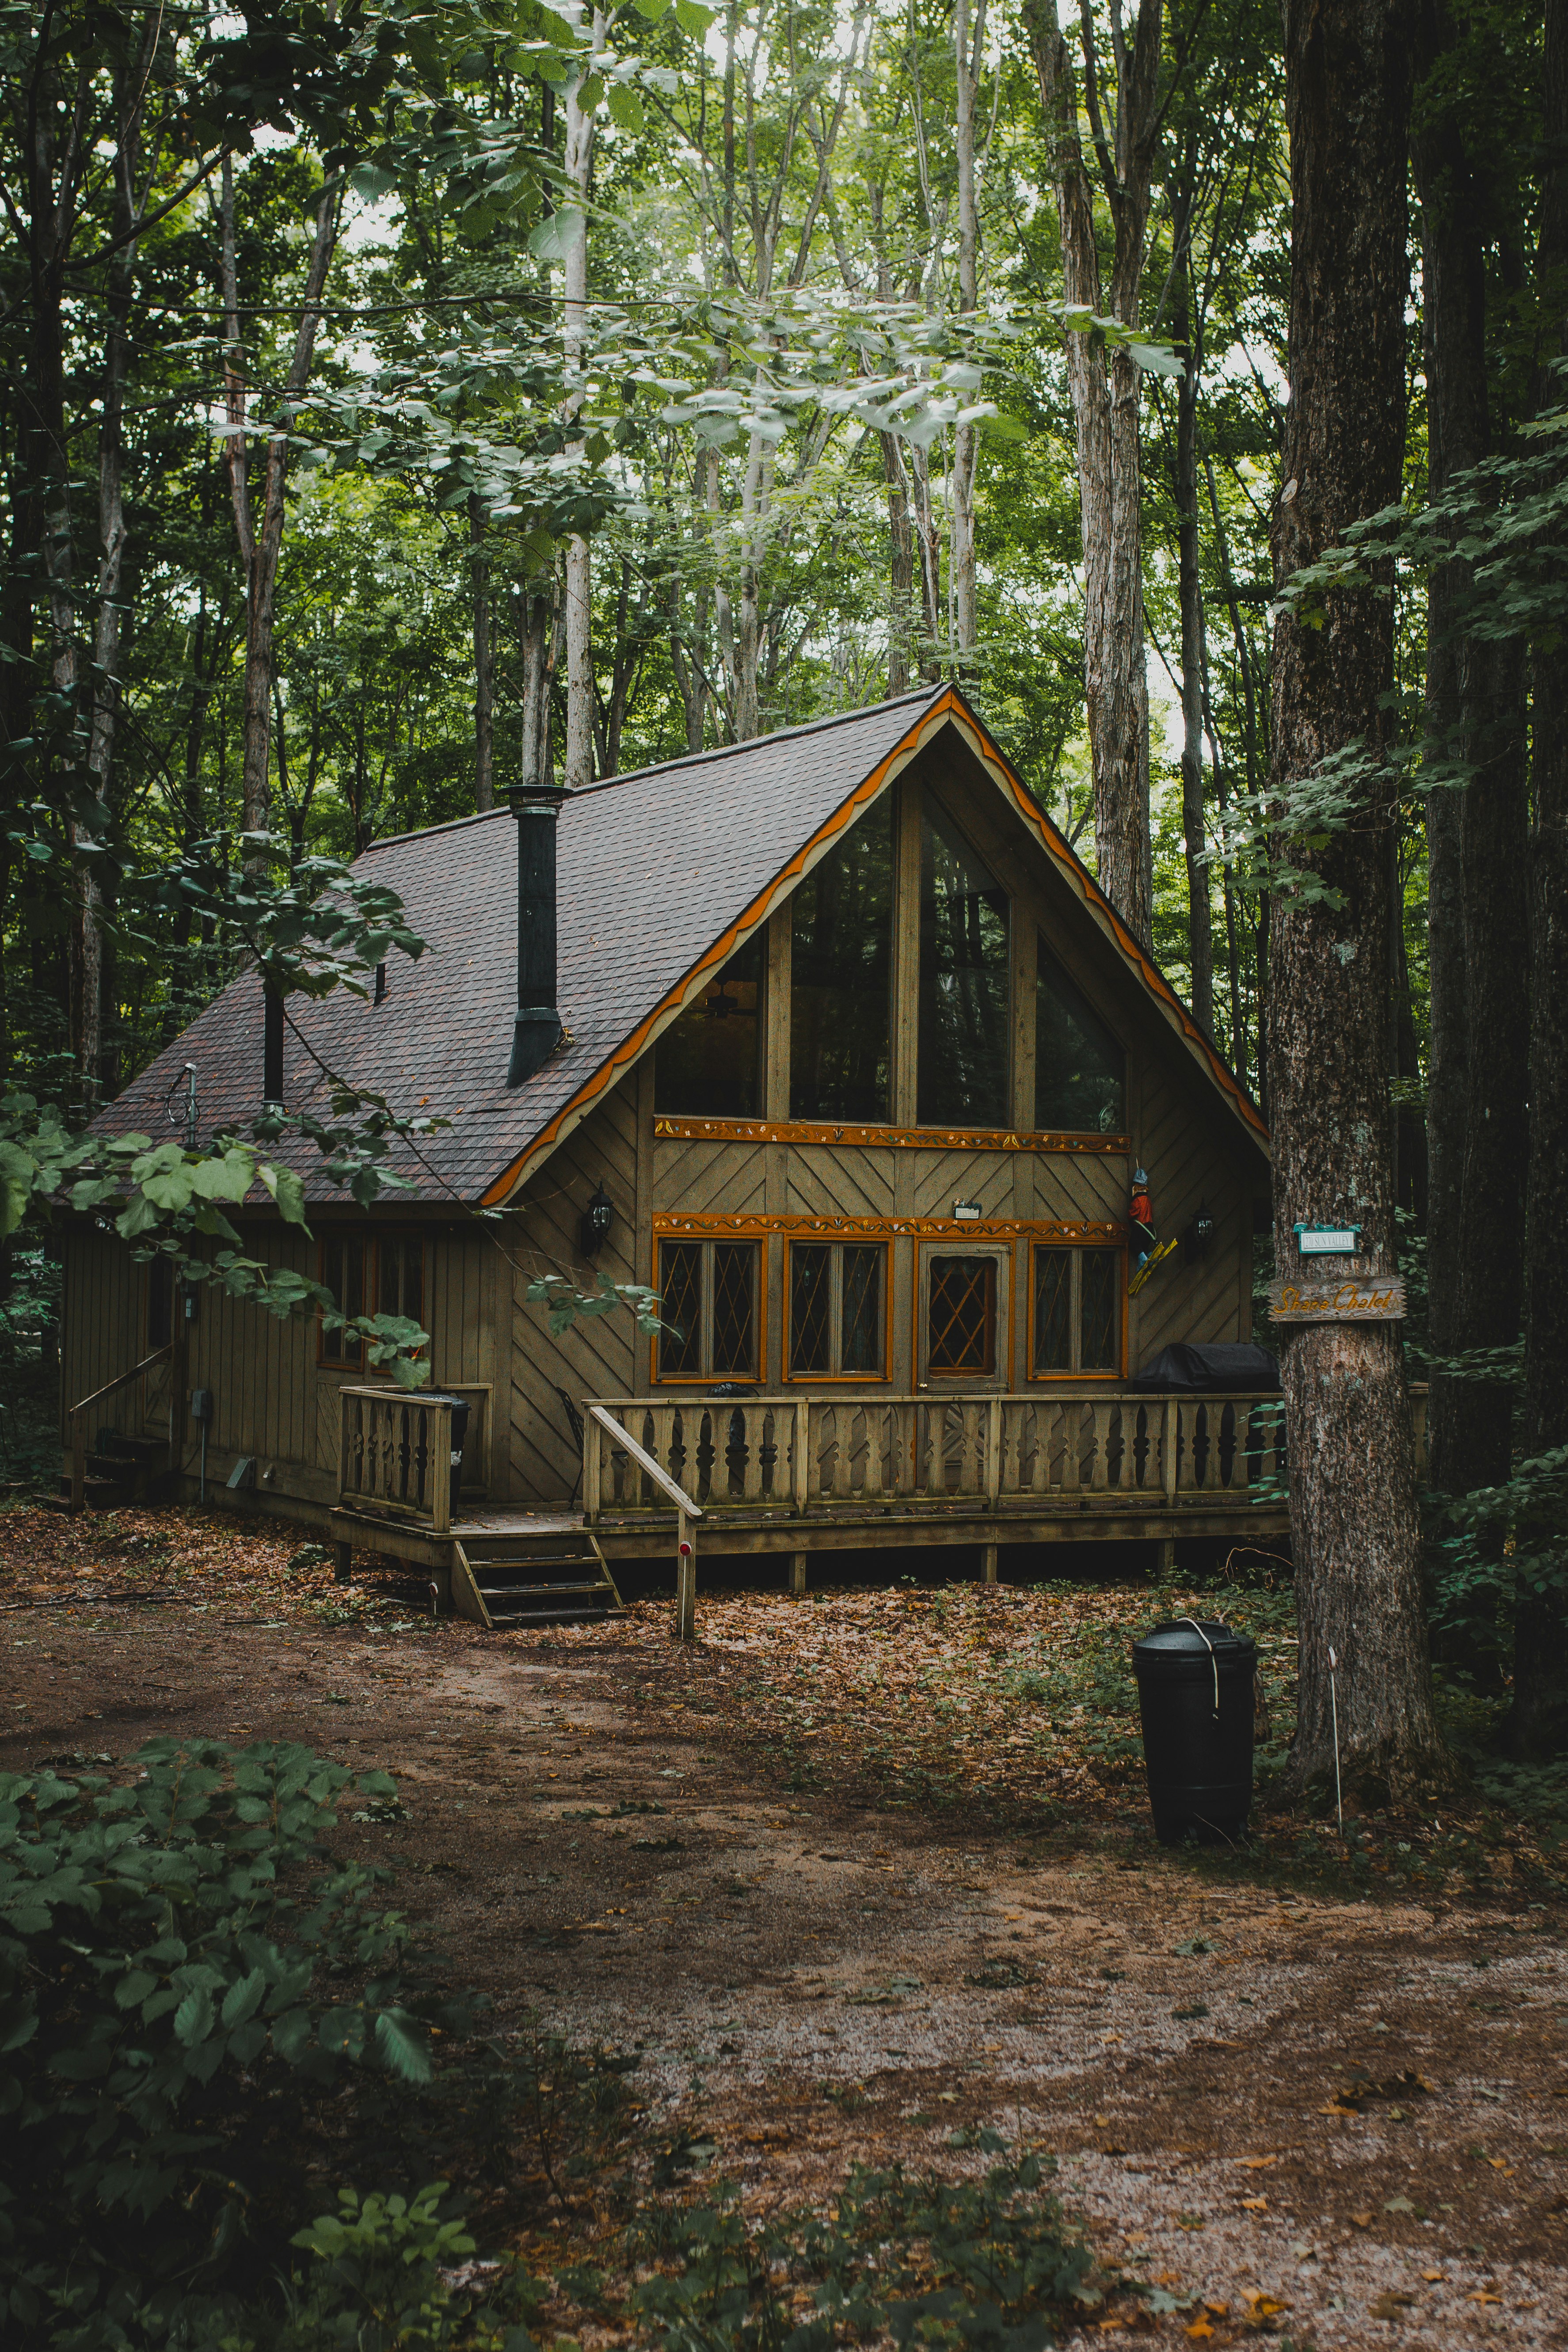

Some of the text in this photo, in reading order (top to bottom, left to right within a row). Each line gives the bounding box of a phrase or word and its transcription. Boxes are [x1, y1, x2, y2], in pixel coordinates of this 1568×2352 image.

[1315, 1236, 1326, 1246] SUN
[1327, 1235, 1350, 1246] VALLEY
[1333, 1284, 1393, 1310] Chalet
